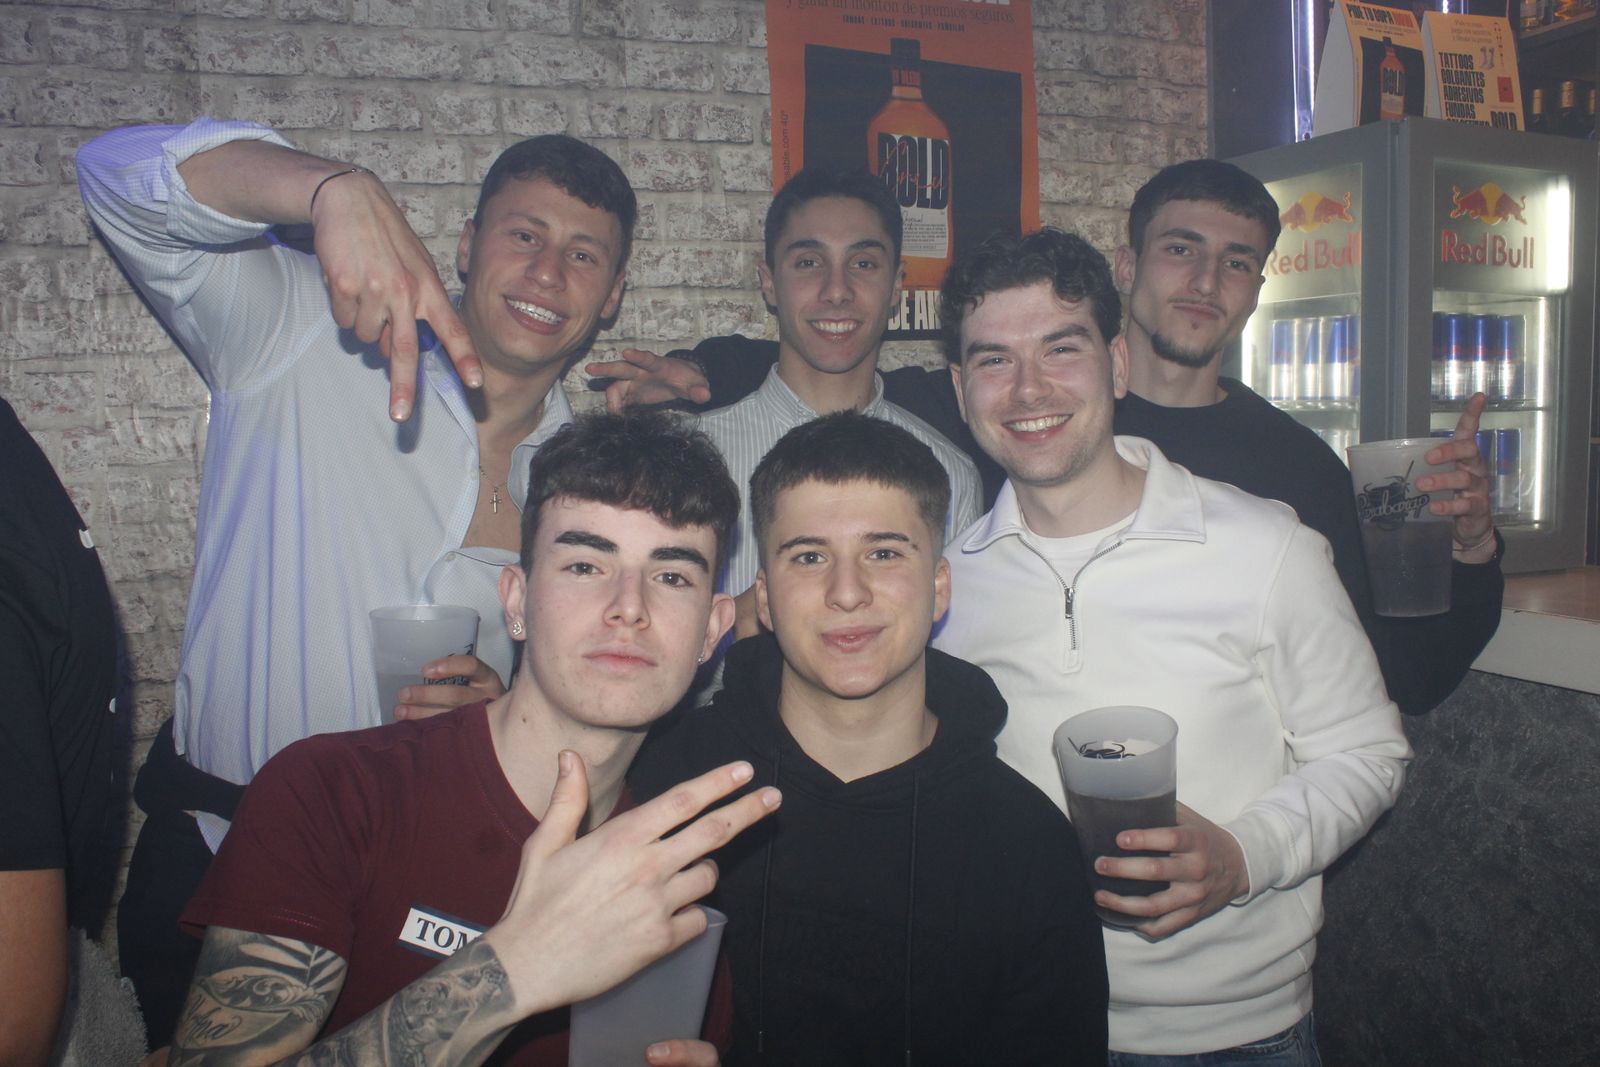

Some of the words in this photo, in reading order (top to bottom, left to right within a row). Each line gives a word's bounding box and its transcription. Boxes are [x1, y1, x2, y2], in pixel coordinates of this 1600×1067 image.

[1438, 51, 1475, 70] TATTOOS
[1441, 69, 1486, 88] COLGANTES
[1443, 84, 1485, 105] ADHESIVOS
[1445, 101, 1477, 120] FUNDAS
[1313, 231, 1361, 270] Bull
[1441, 229, 1489, 265] Red
[1491, 234, 1535, 269] Bull
